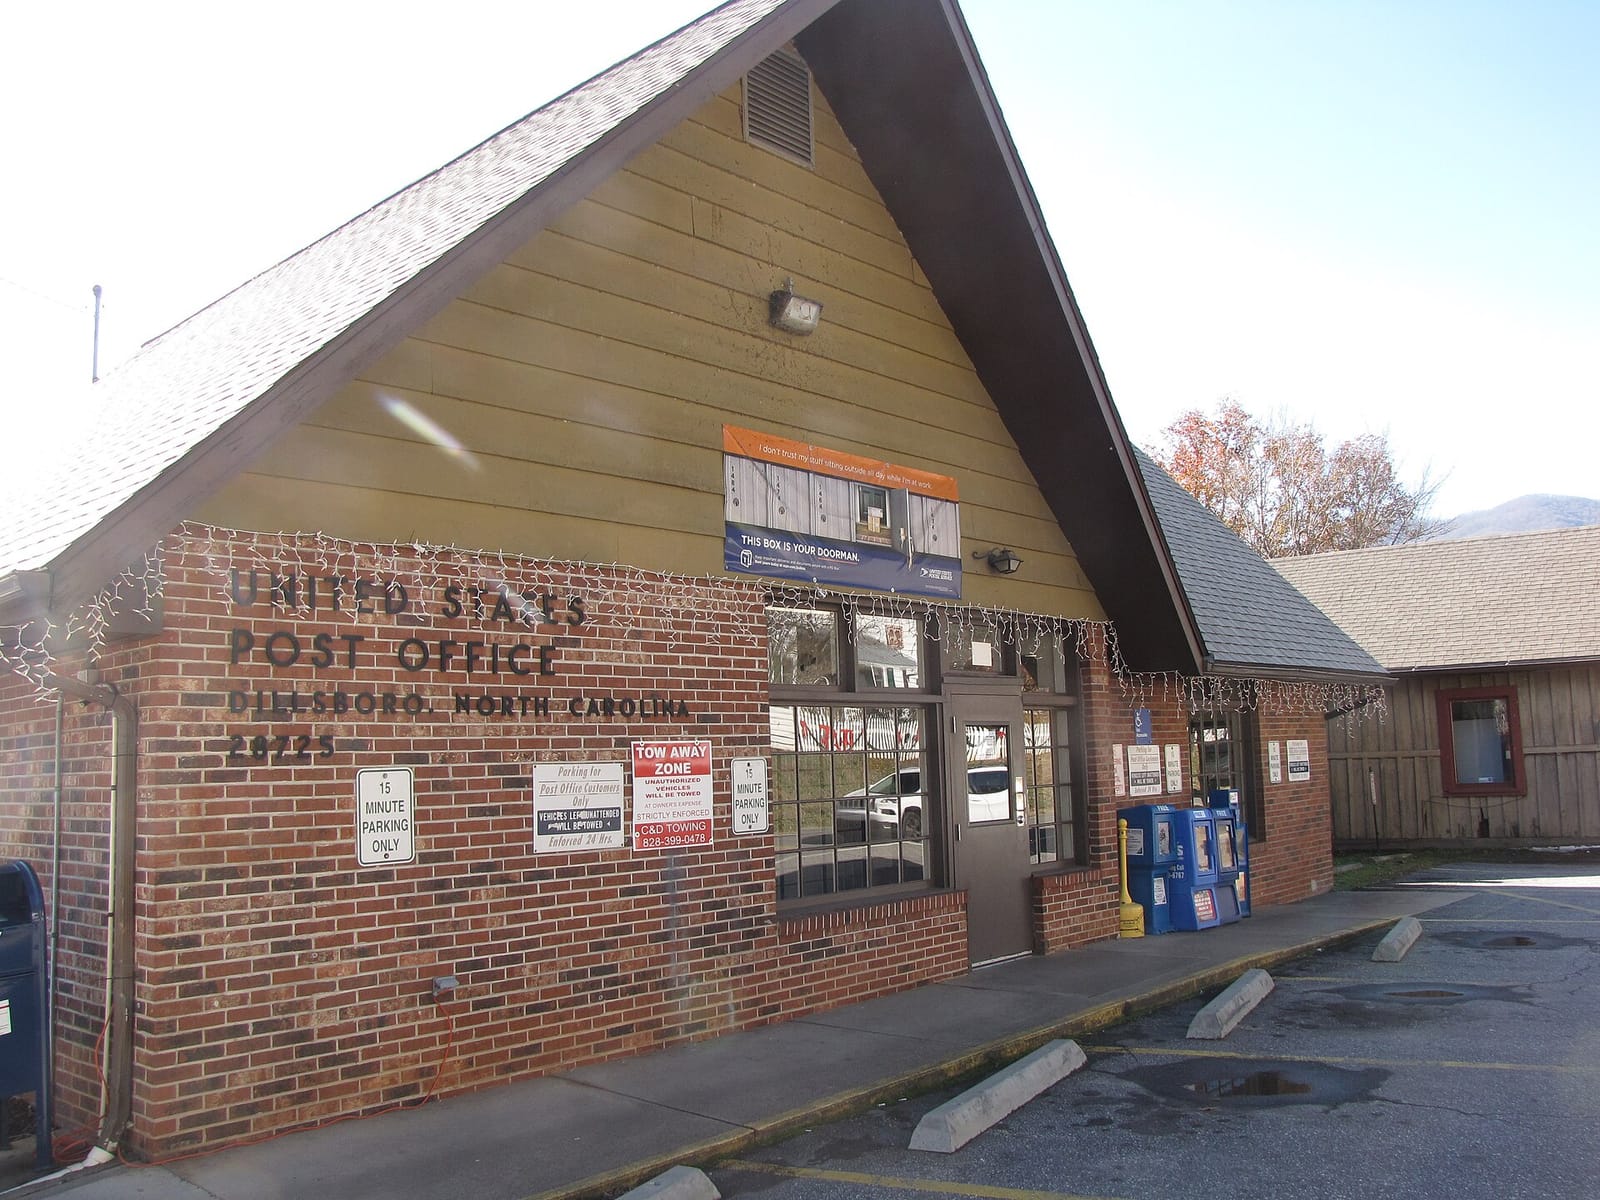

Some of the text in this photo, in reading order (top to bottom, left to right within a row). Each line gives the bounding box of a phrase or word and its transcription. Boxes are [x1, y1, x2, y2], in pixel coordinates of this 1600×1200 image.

[762, 445, 781, 455] don't
[781, 449, 797, 460] trust
[798, 454, 809, 463] my
[809, 455, 824, 465] stuff
[844, 465, 866, 475] outside
[875, 471, 886, 481] day
[741, 534, 860, 562] THIS BOX IS YOUR DOORMAN.
[231, 568, 585, 627] UNITED STATES
[231, 628, 556, 676] POST OFFICE
[455, 692, 549, 717] NORTH
[568, 696, 690, 718] CAROLINA
[229, 735, 335, 760] 28725
[635, 745, 707, 759] TOW AWAY
[557, 765, 601, 779] Parking for
[654, 762, 692, 775] ZONE
[745, 768, 753, 779] 15
[379, 782, 391, 794] 15
[644, 777, 702, 785] UNAUTHORIZED
[540, 782, 620, 795] Post Office Customers
[736, 783, 763, 794] MINUTE
[365, 800, 405, 815] MINUTE
[572, 795, 590, 808] Only
[735, 797, 765, 810] PARKING
[586, 809, 620, 819] UNATTENDED
[636, 809, 710, 821] STRICTLY ENFORCED
[741, 813, 759, 824] ONLY
[362, 819, 409, 834] PARKING
[582, 820, 603, 830] TOWED
[641, 821, 706, 835] C&D TOWING
[372, 838, 400, 853] ONLY
[548, 834, 584, 848] Enforced
[586, 833, 597, 845] 24
[642, 833, 706, 848] 828-399-0478
